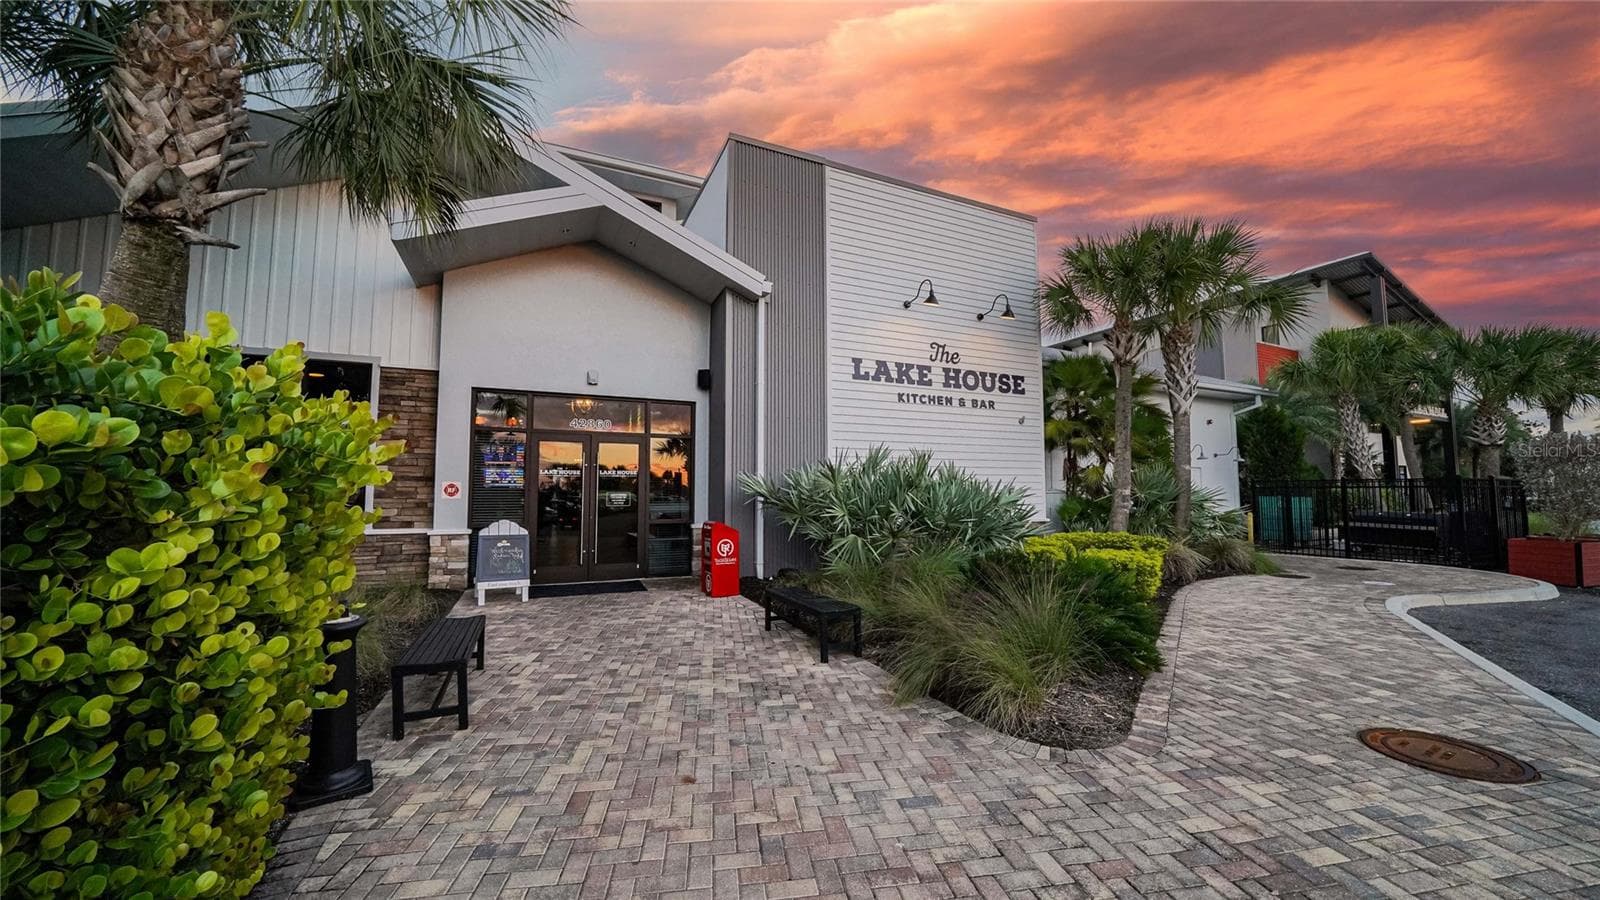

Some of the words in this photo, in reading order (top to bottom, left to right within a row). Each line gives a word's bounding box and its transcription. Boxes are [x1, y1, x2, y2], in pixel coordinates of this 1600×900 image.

[929, 342, 961, 365] The
[851, 357, 933, 387] LAKE
[942, 367, 1026, 395] HOUSE
[897, 392, 954, 407] KITCHEN
[958, 397, 966, 407] &
[971, 399, 996, 410] BAR
